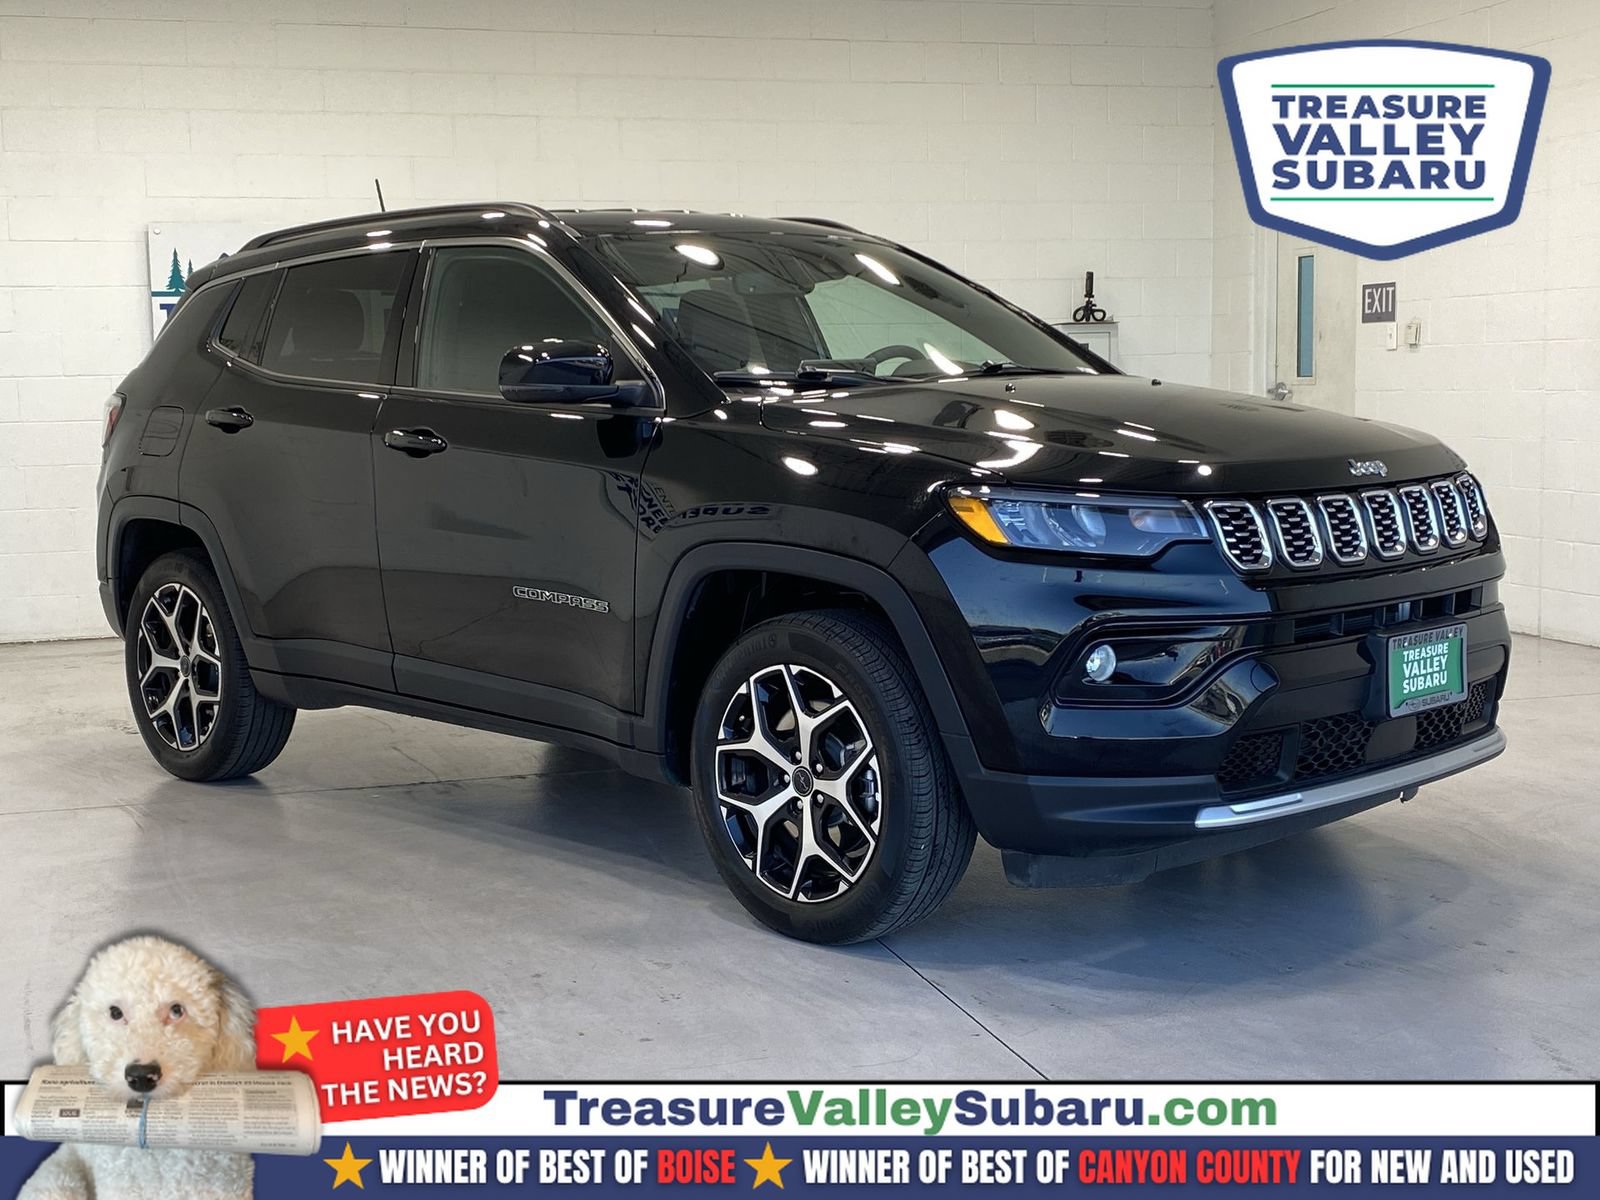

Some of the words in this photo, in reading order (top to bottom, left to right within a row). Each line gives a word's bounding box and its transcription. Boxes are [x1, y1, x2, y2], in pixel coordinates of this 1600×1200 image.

[1364, 287, 1395, 314] EXIT
[1348, 459, 1388, 477] Jeep
[513, 585, 610, 613] COMPASS
[1403, 643, 1449, 662] TREASURE
[1403, 655, 1448, 678] VALLEY
[1403, 671, 1448, 694] SUBARU
